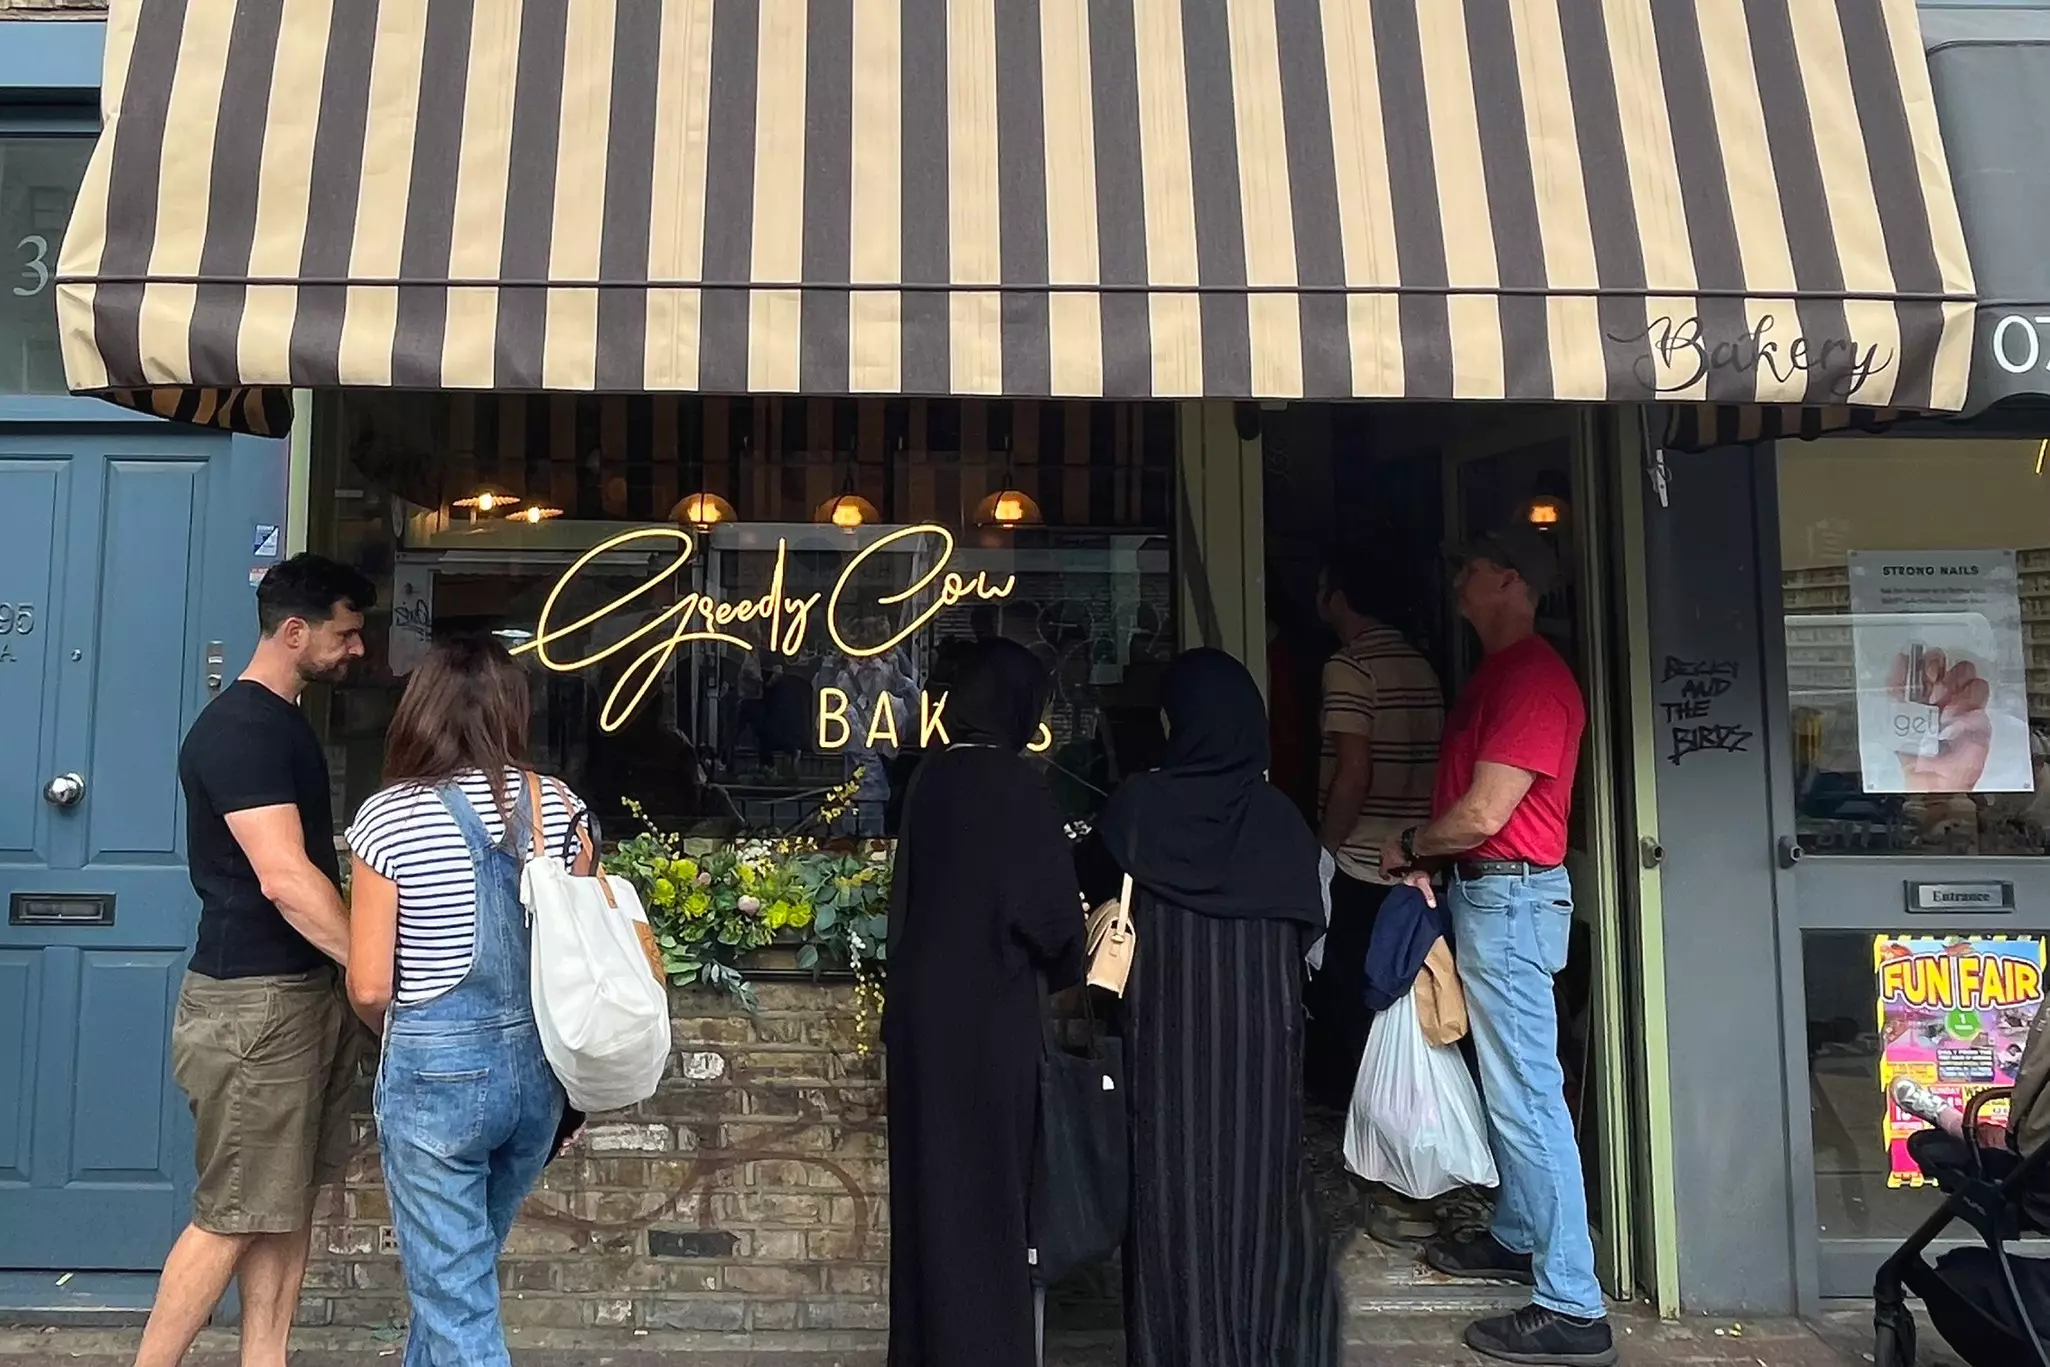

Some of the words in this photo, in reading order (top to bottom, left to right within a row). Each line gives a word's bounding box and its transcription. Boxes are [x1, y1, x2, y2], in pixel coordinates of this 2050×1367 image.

[1606, 314, 1894, 396] Bakery
[1940, 565, 1979, 576] NAILS
[508, 527, 822, 732] Greedy
[827, 524, 1015, 657] Cow
[1681, 677, 1732, 699] AND
[1659, 699, 1711, 723] THE
[1932, 890, 1991, 902] Entrance
[1882, 954, 1954, 1008] FUN
[1957, 954, 2041, 1008] FAIR
